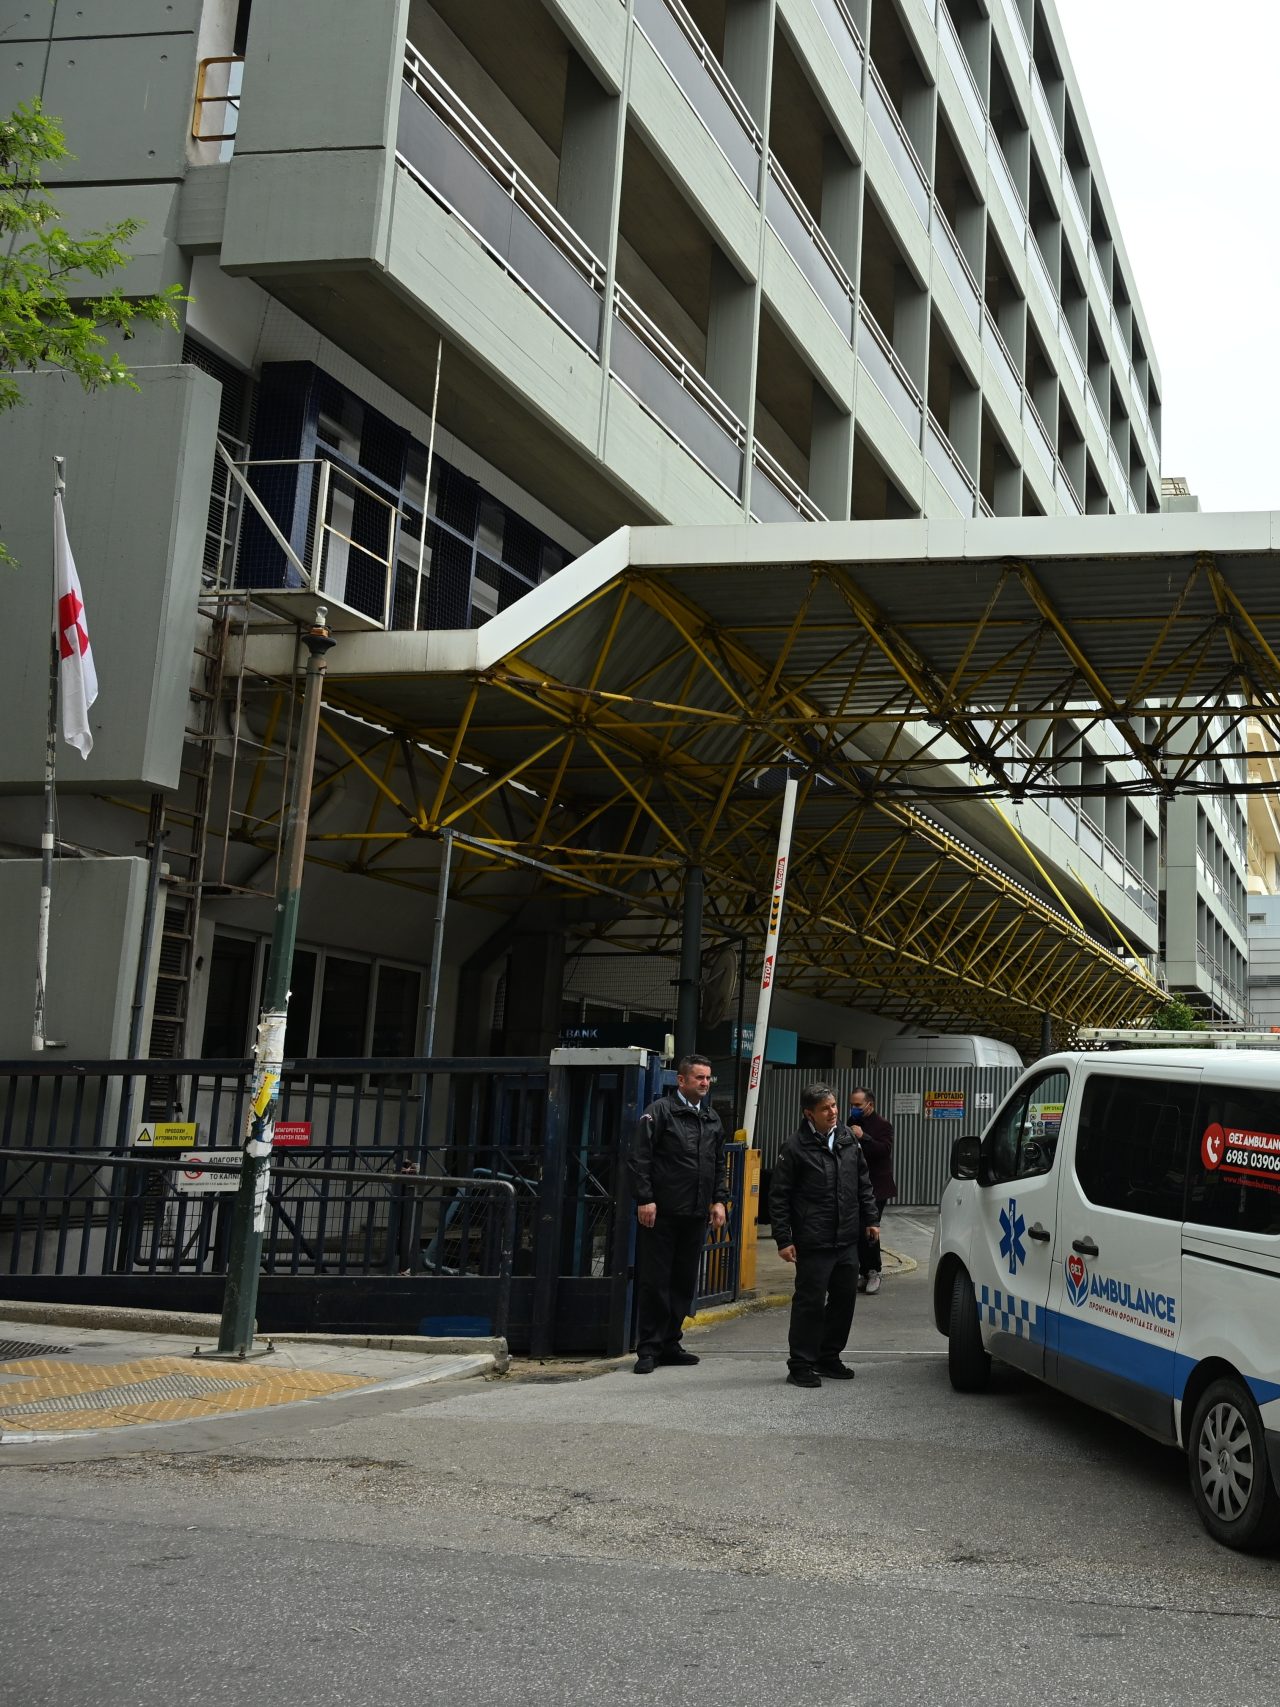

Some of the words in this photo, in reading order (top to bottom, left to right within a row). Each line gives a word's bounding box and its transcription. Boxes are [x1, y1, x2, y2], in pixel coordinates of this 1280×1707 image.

[776, 860, 785, 887] Nicolis
[764, 961, 772, 983] STOP
[751, 1059, 760, 1086] Nicolis
[1228, 1132, 1243, 1145] ΘΕΣ
[1226, 1149, 1248, 1166] 6985
[1070, 1263, 1082, 1276] ΘΕΣ
[1090, 1272, 1176, 1324] AMBULANCE
[1088, 1301, 1118, 1319] ΠΡΟΗΓΜΕΝΗ
[1119, 1312, 1145, 1328] ΦΡΟΝΤΙΔΑ
[1146, 1322, 1153, 1331] ΣΕ
[1154, 1324, 1174, 1338] ΚΙΝΗΣΗ
